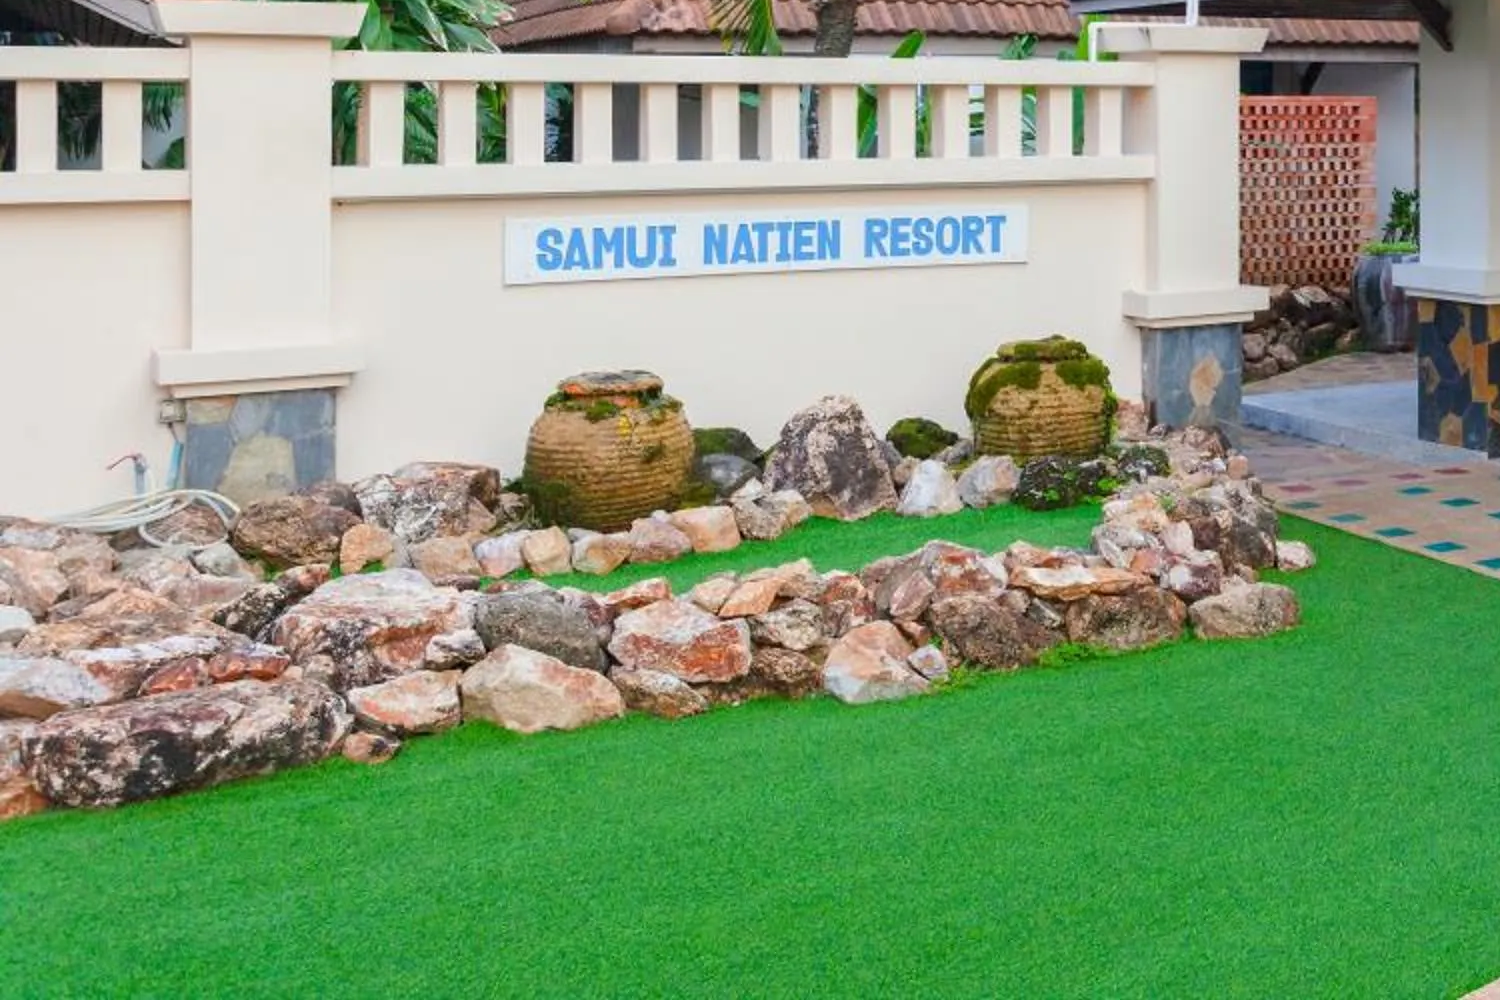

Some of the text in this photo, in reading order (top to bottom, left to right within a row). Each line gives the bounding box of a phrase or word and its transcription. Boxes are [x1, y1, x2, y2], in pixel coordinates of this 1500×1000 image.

[536, 215, 1006, 271] SAMUI NATIEN RESORT
